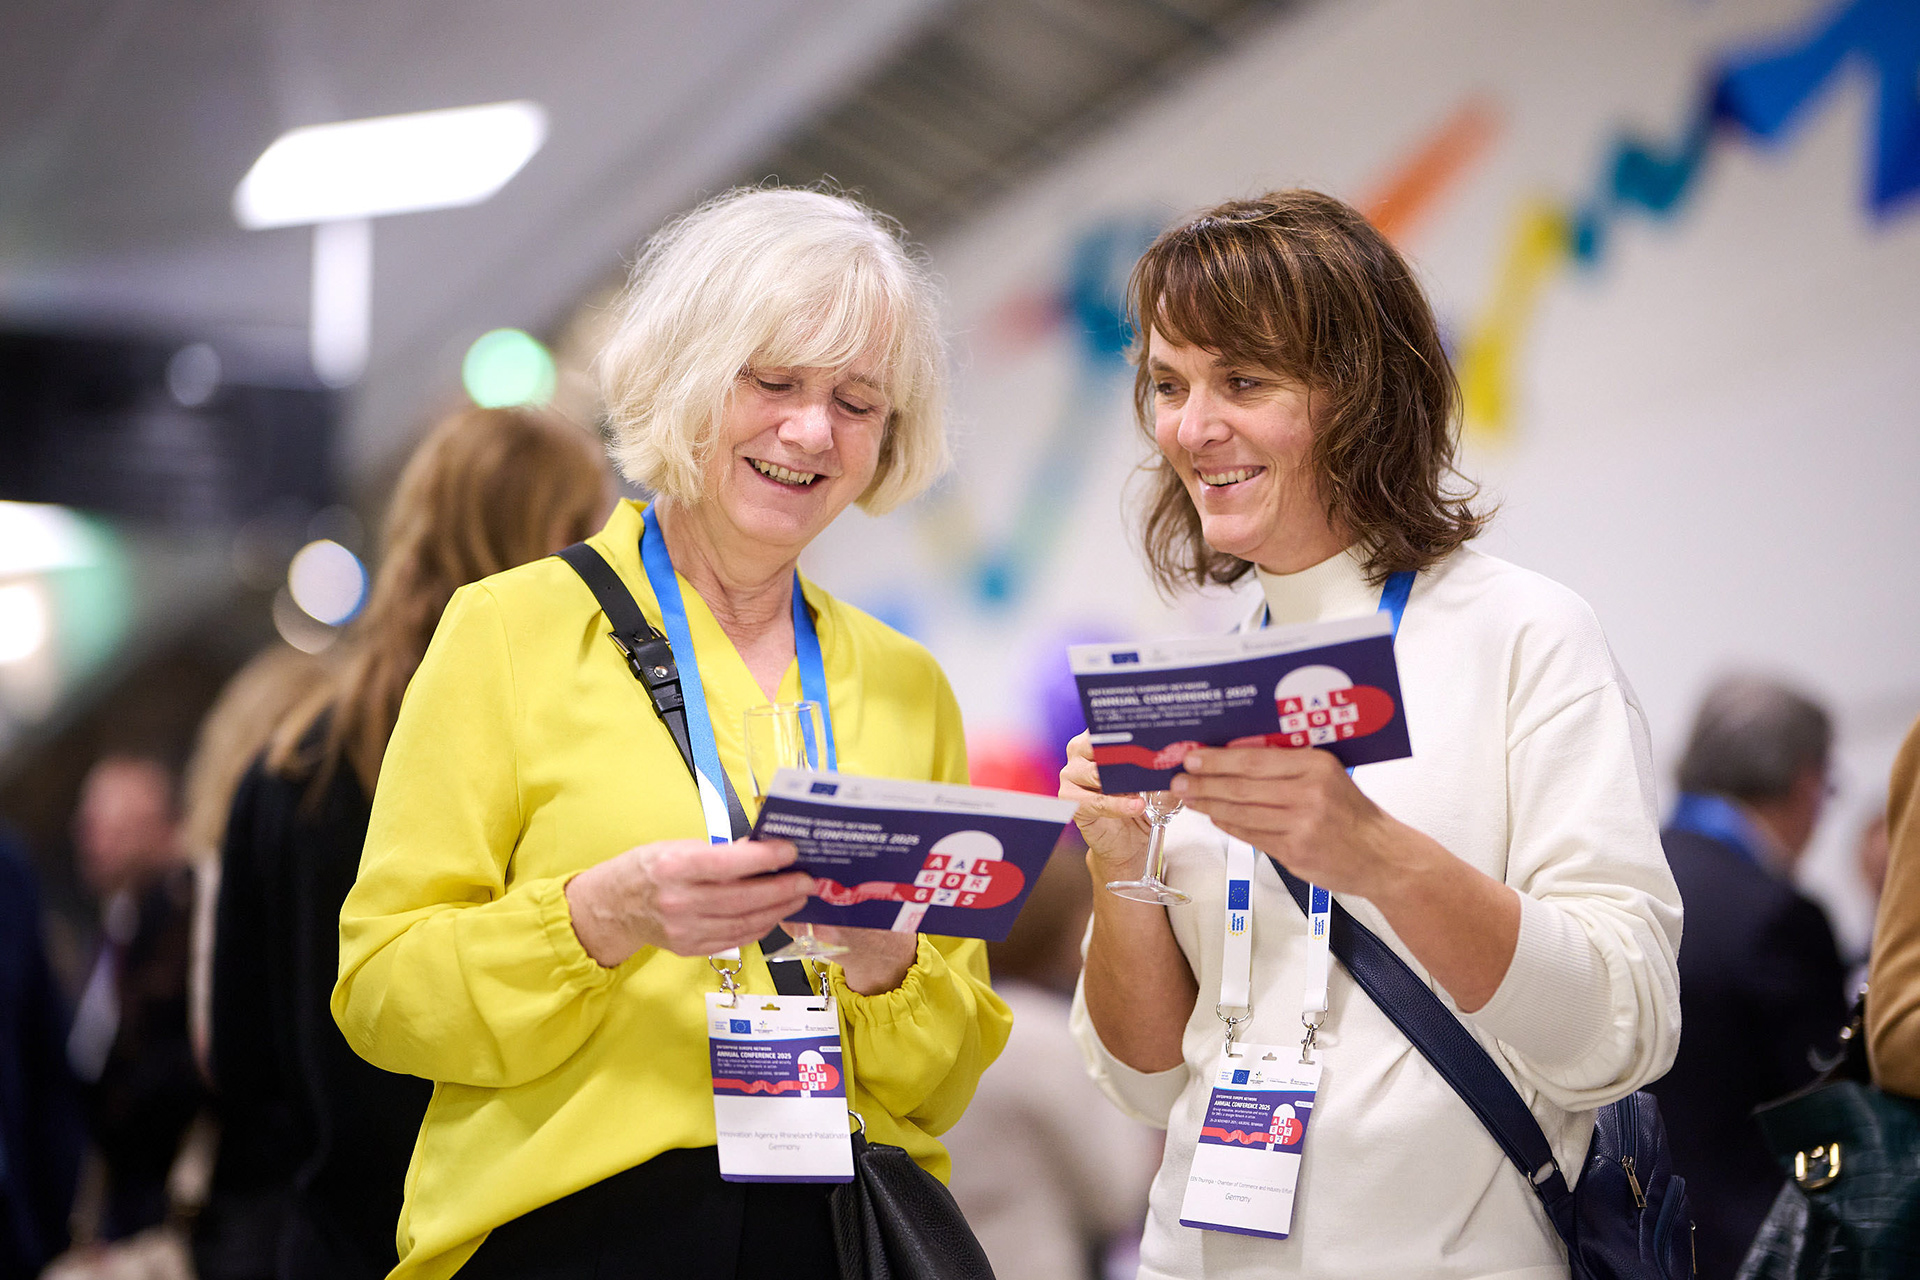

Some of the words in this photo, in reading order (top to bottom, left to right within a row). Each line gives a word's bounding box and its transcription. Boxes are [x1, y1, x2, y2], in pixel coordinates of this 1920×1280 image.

[1090, 695, 1140, 707] ANNUAL
[1142, 688, 1223, 705] CONFERENCE
[1224, 684, 1258, 699] 2025
[762, 822, 811, 838] ANNUAL
[812, 827, 889, 844] CONFERENCE
[889, 832, 921, 846] 2025
[777, 1052, 792, 1060] 2025
[1231, 1101, 1258, 1110] CONFERENCE
[719, 1131, 752, 1139] Innovation
[754, 1131, 778, 1140] Agency
[768, 1143, 801, 1151] Germany
[1217, 1179, 1233, 1187] Chamber
[1239, 1182, 1258, 1190] Commerce
[1225, 1192, 1251, 1203] Germany
